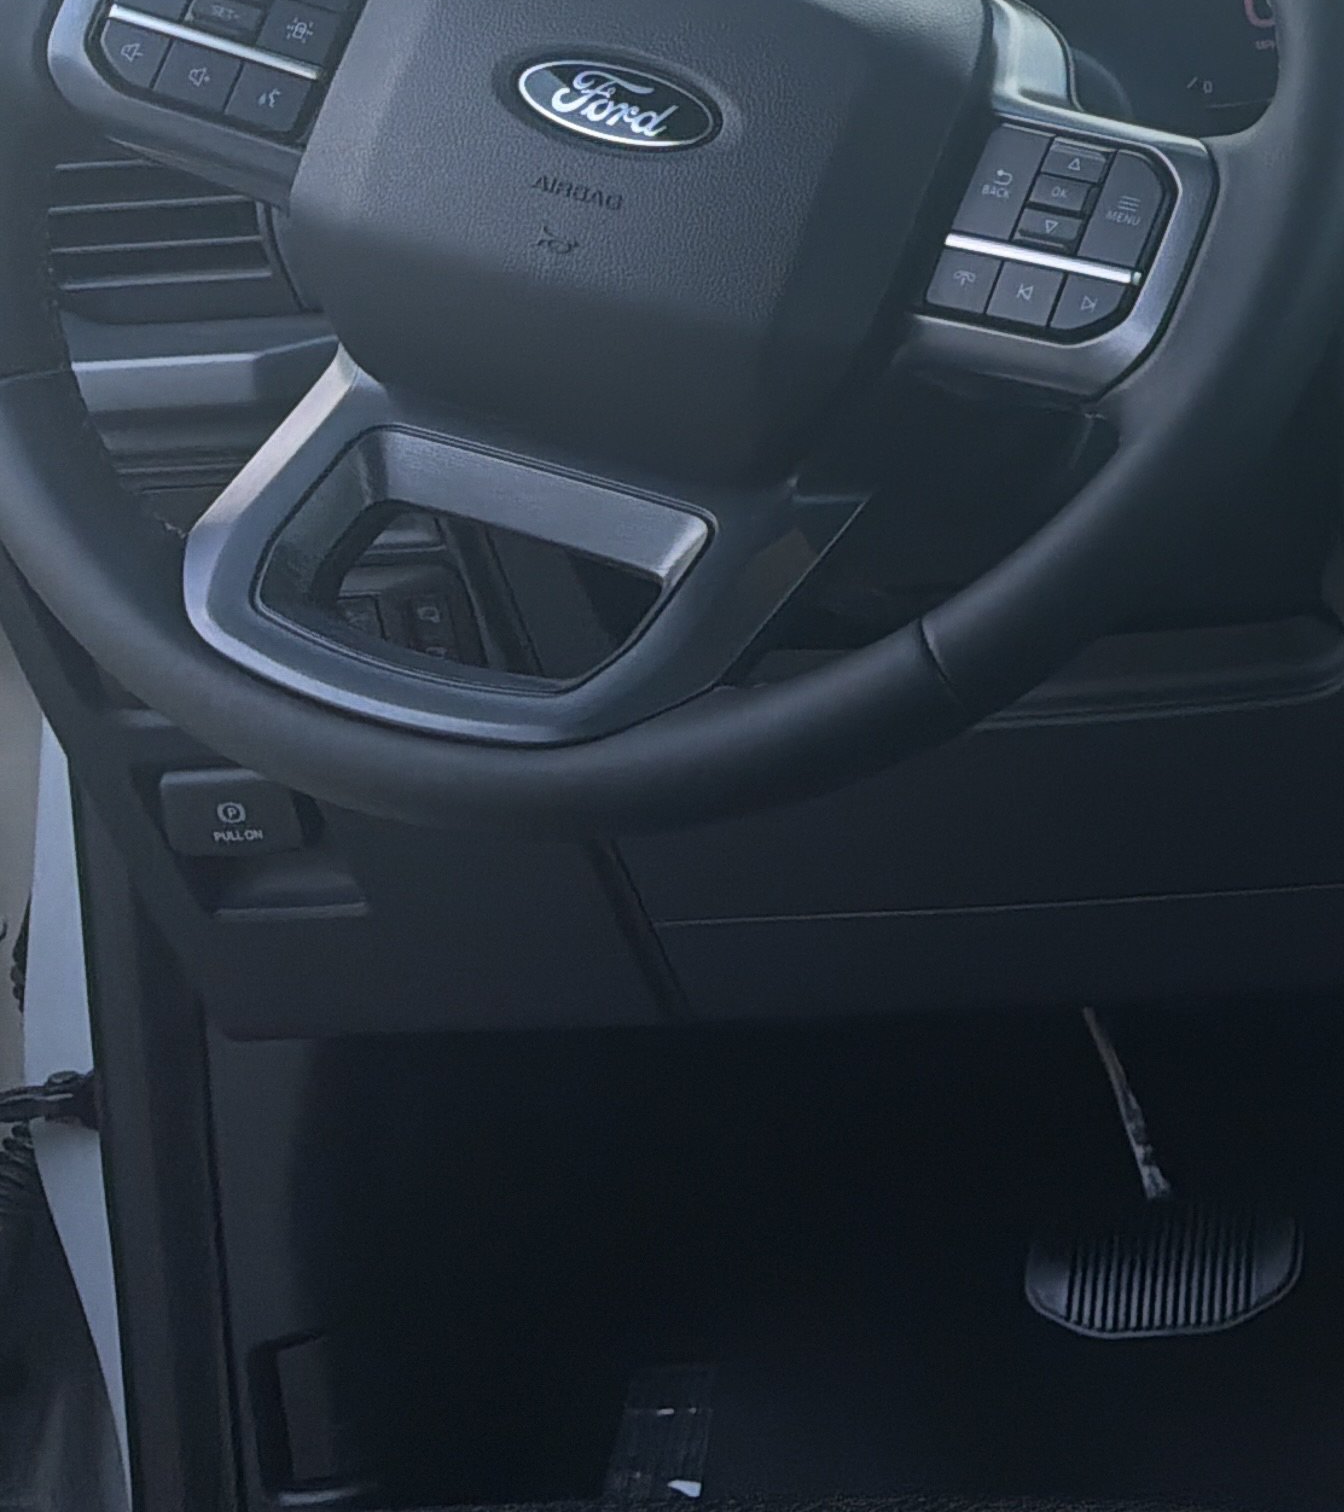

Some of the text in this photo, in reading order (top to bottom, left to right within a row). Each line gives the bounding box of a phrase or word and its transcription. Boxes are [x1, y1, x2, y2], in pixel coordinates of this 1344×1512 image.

[552, 70, 679, 137] Ford
[981, 184, 1009, 199] BACK
[1051, 186, 1067, 199] OK
[1105, 209, 1142, 227] MENU
[213, 829, 264, 842] PULL ON
